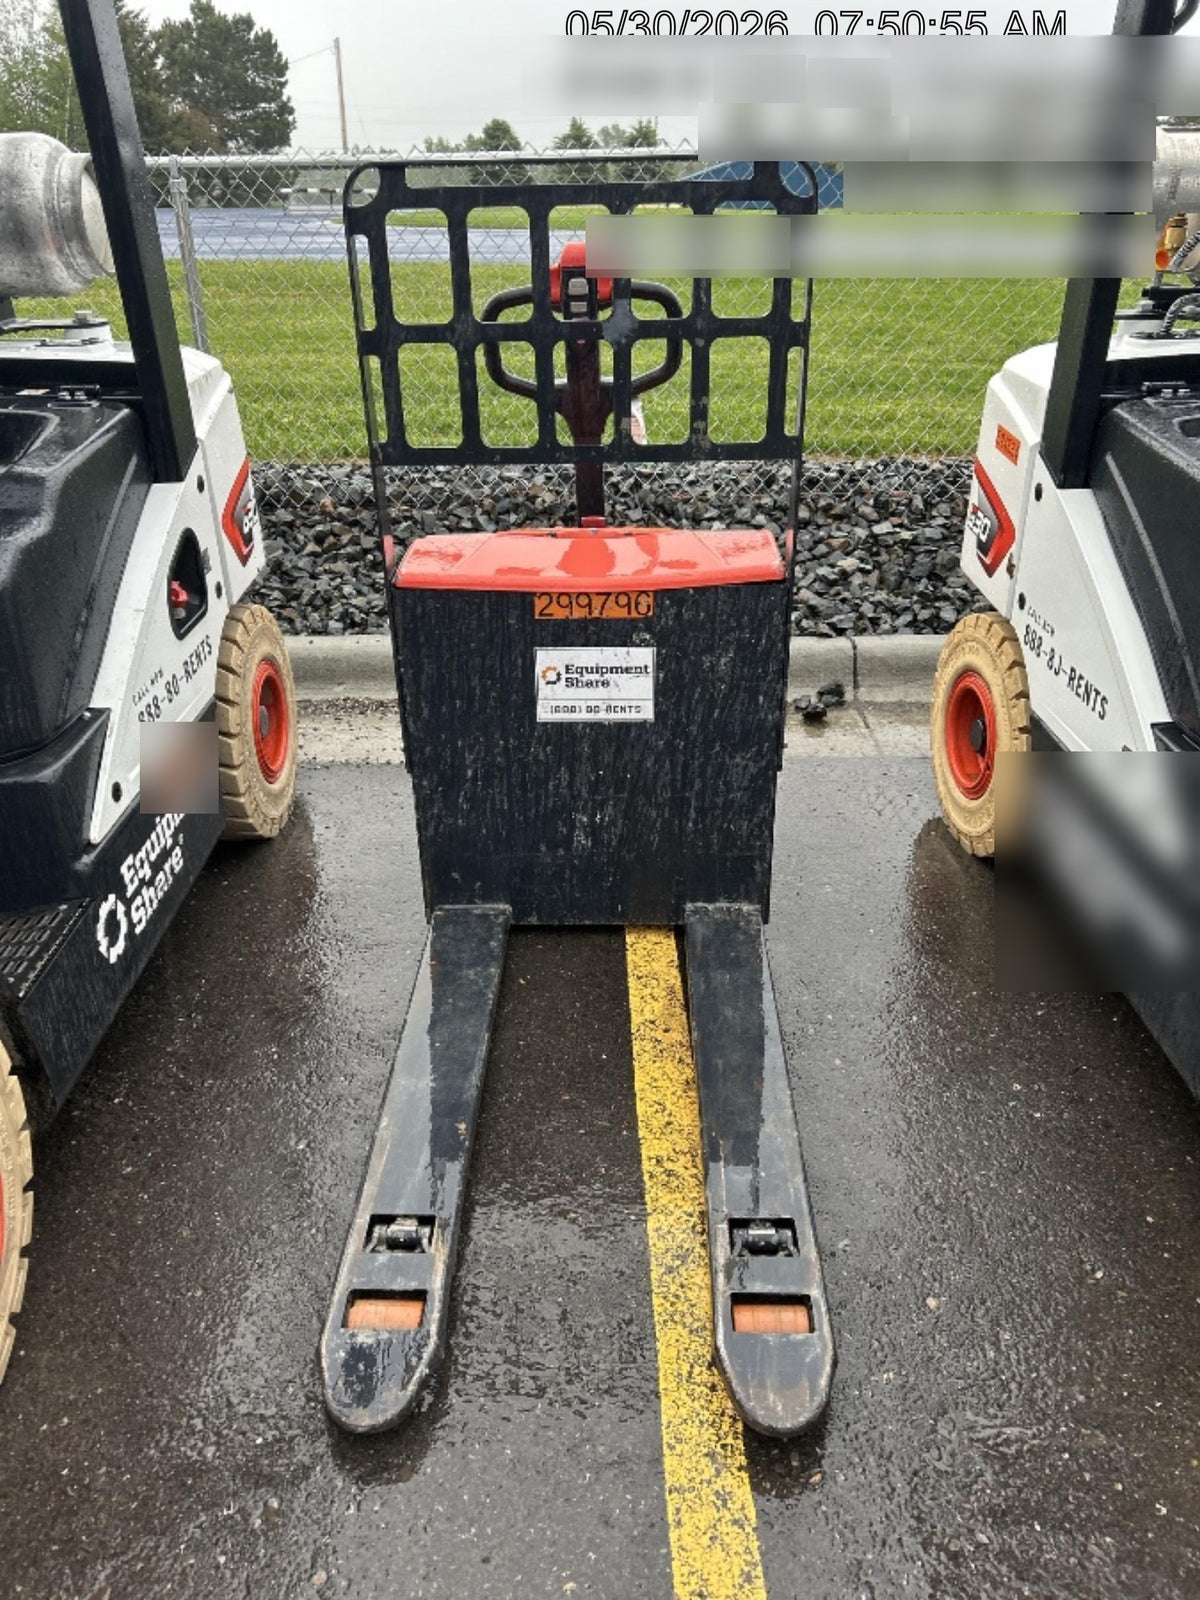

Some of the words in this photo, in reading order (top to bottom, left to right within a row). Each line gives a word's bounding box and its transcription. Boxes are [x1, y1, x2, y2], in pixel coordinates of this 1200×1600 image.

[564, 663, 649, 677] Equipment
[564, 677, 610, 688] Share
[120, 813, 186, 898] Equip
[131, 846, 184, 935] Share
